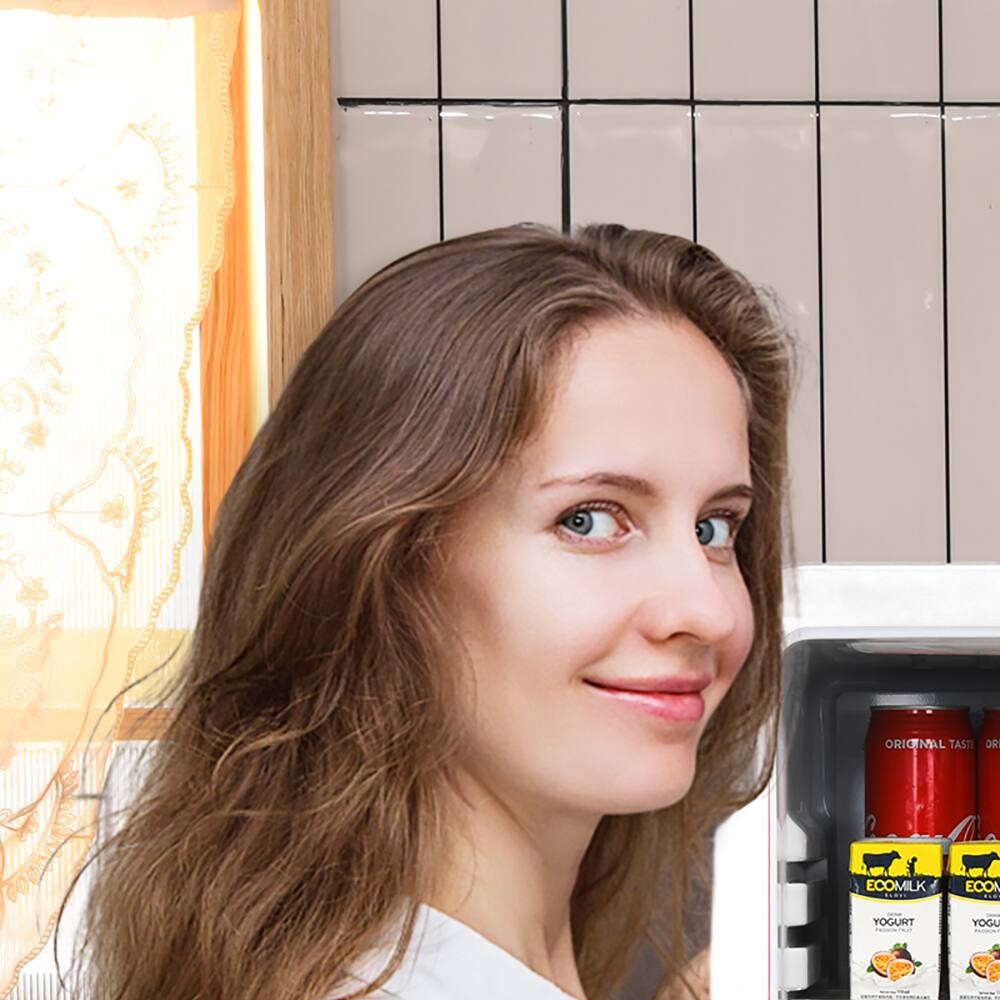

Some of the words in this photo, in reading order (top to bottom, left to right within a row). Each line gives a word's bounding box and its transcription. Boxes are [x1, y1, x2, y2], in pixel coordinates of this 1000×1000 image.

[884, 738, 946, 749] ORIGINAL
[866, 880, 926, 892] ECOMILK
[872, 918, 915, 927] YOGURT
